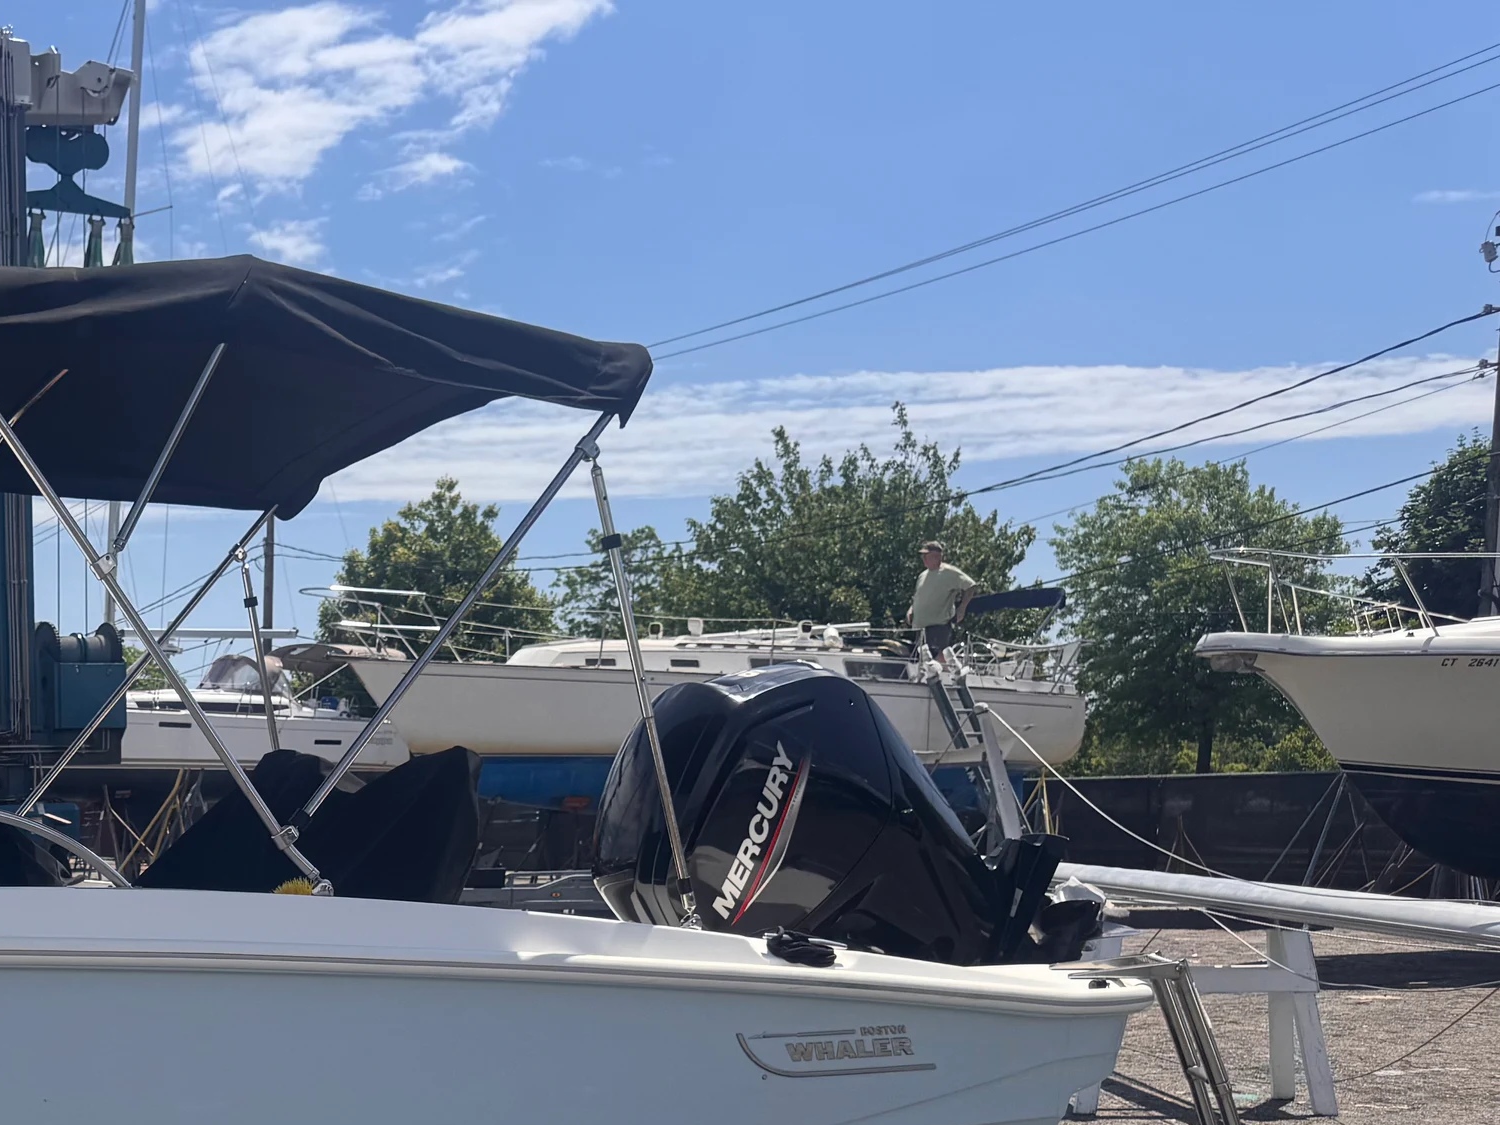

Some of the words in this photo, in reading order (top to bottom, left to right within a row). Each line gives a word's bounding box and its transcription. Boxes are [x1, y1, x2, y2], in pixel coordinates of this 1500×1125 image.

[1441, 658, 1458, 667] CT
[1468, 658, 1500, 667] 2641
[712, 740, 793, 920] MERCURY
[860, 1025, 907, 1037] BOSTON
[785, 1036, 915, 1062] WHALER
